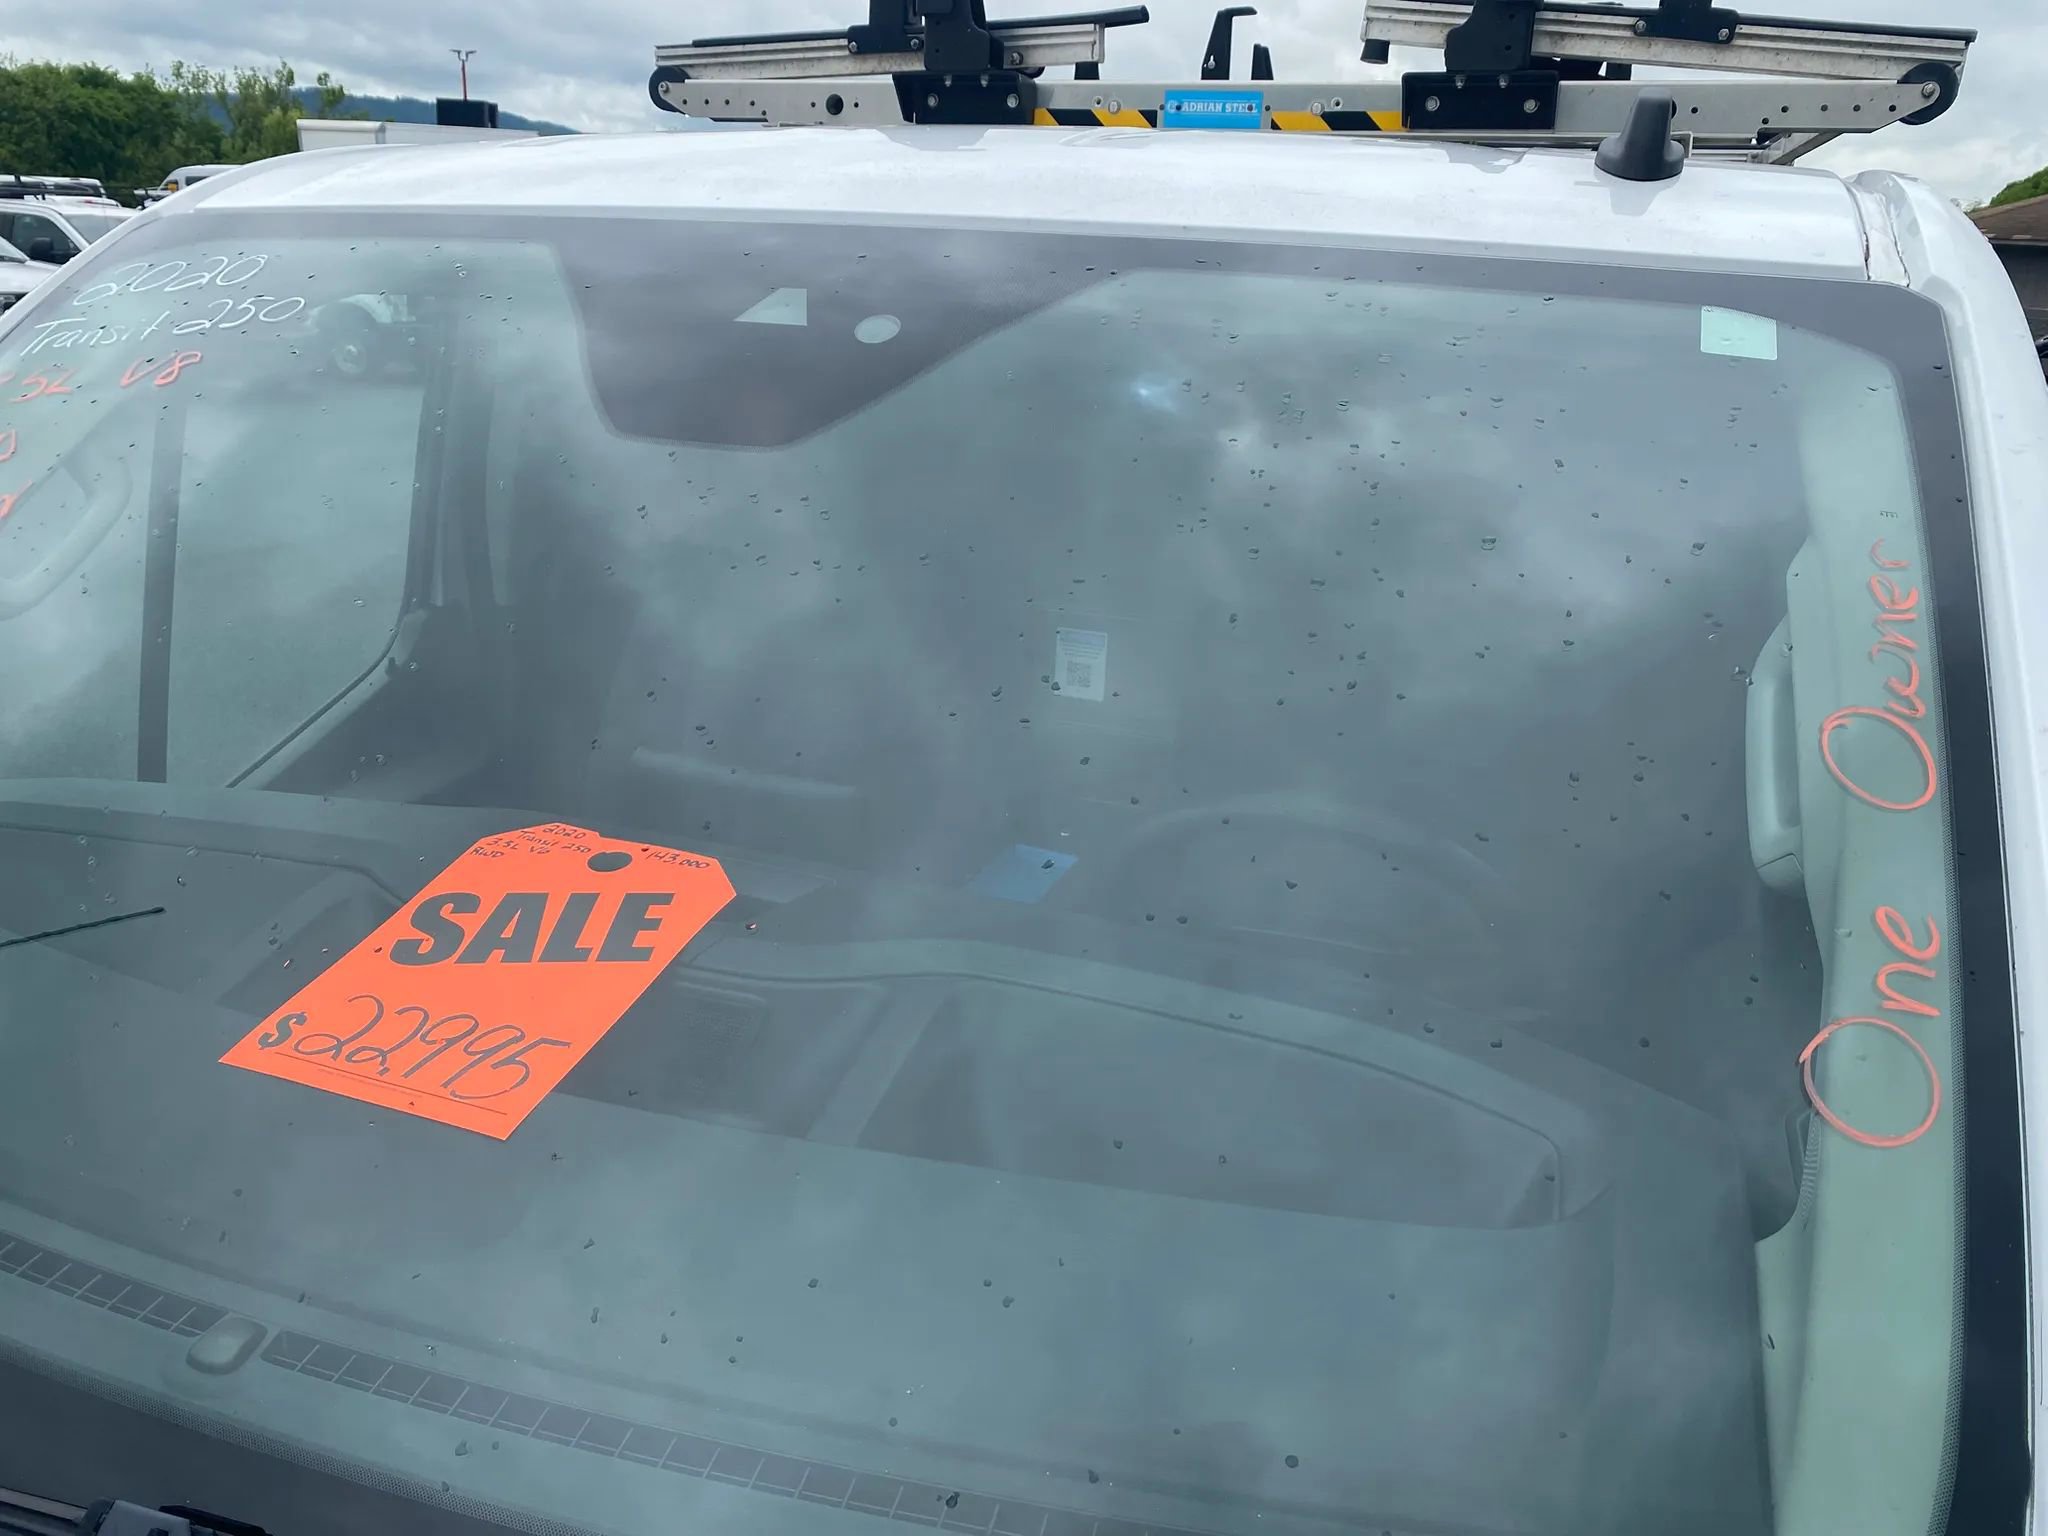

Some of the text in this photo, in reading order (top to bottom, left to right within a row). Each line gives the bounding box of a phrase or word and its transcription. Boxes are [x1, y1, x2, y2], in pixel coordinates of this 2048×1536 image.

[1182, 101, 1222, 112] ADRIAN
[73, 255, 269, 306] 2020
[20, 297, 305, 356] Transit 250
[516, 830, 591, 855] Transit 250
[542, 824, 587, 840] 2020
[1800, 538, 1942, 1148] One Owner
[470, 847, 505, 859] AWD
[645, 850, 710, 869] 143,000
[389, 891, 676, 967] SALE
